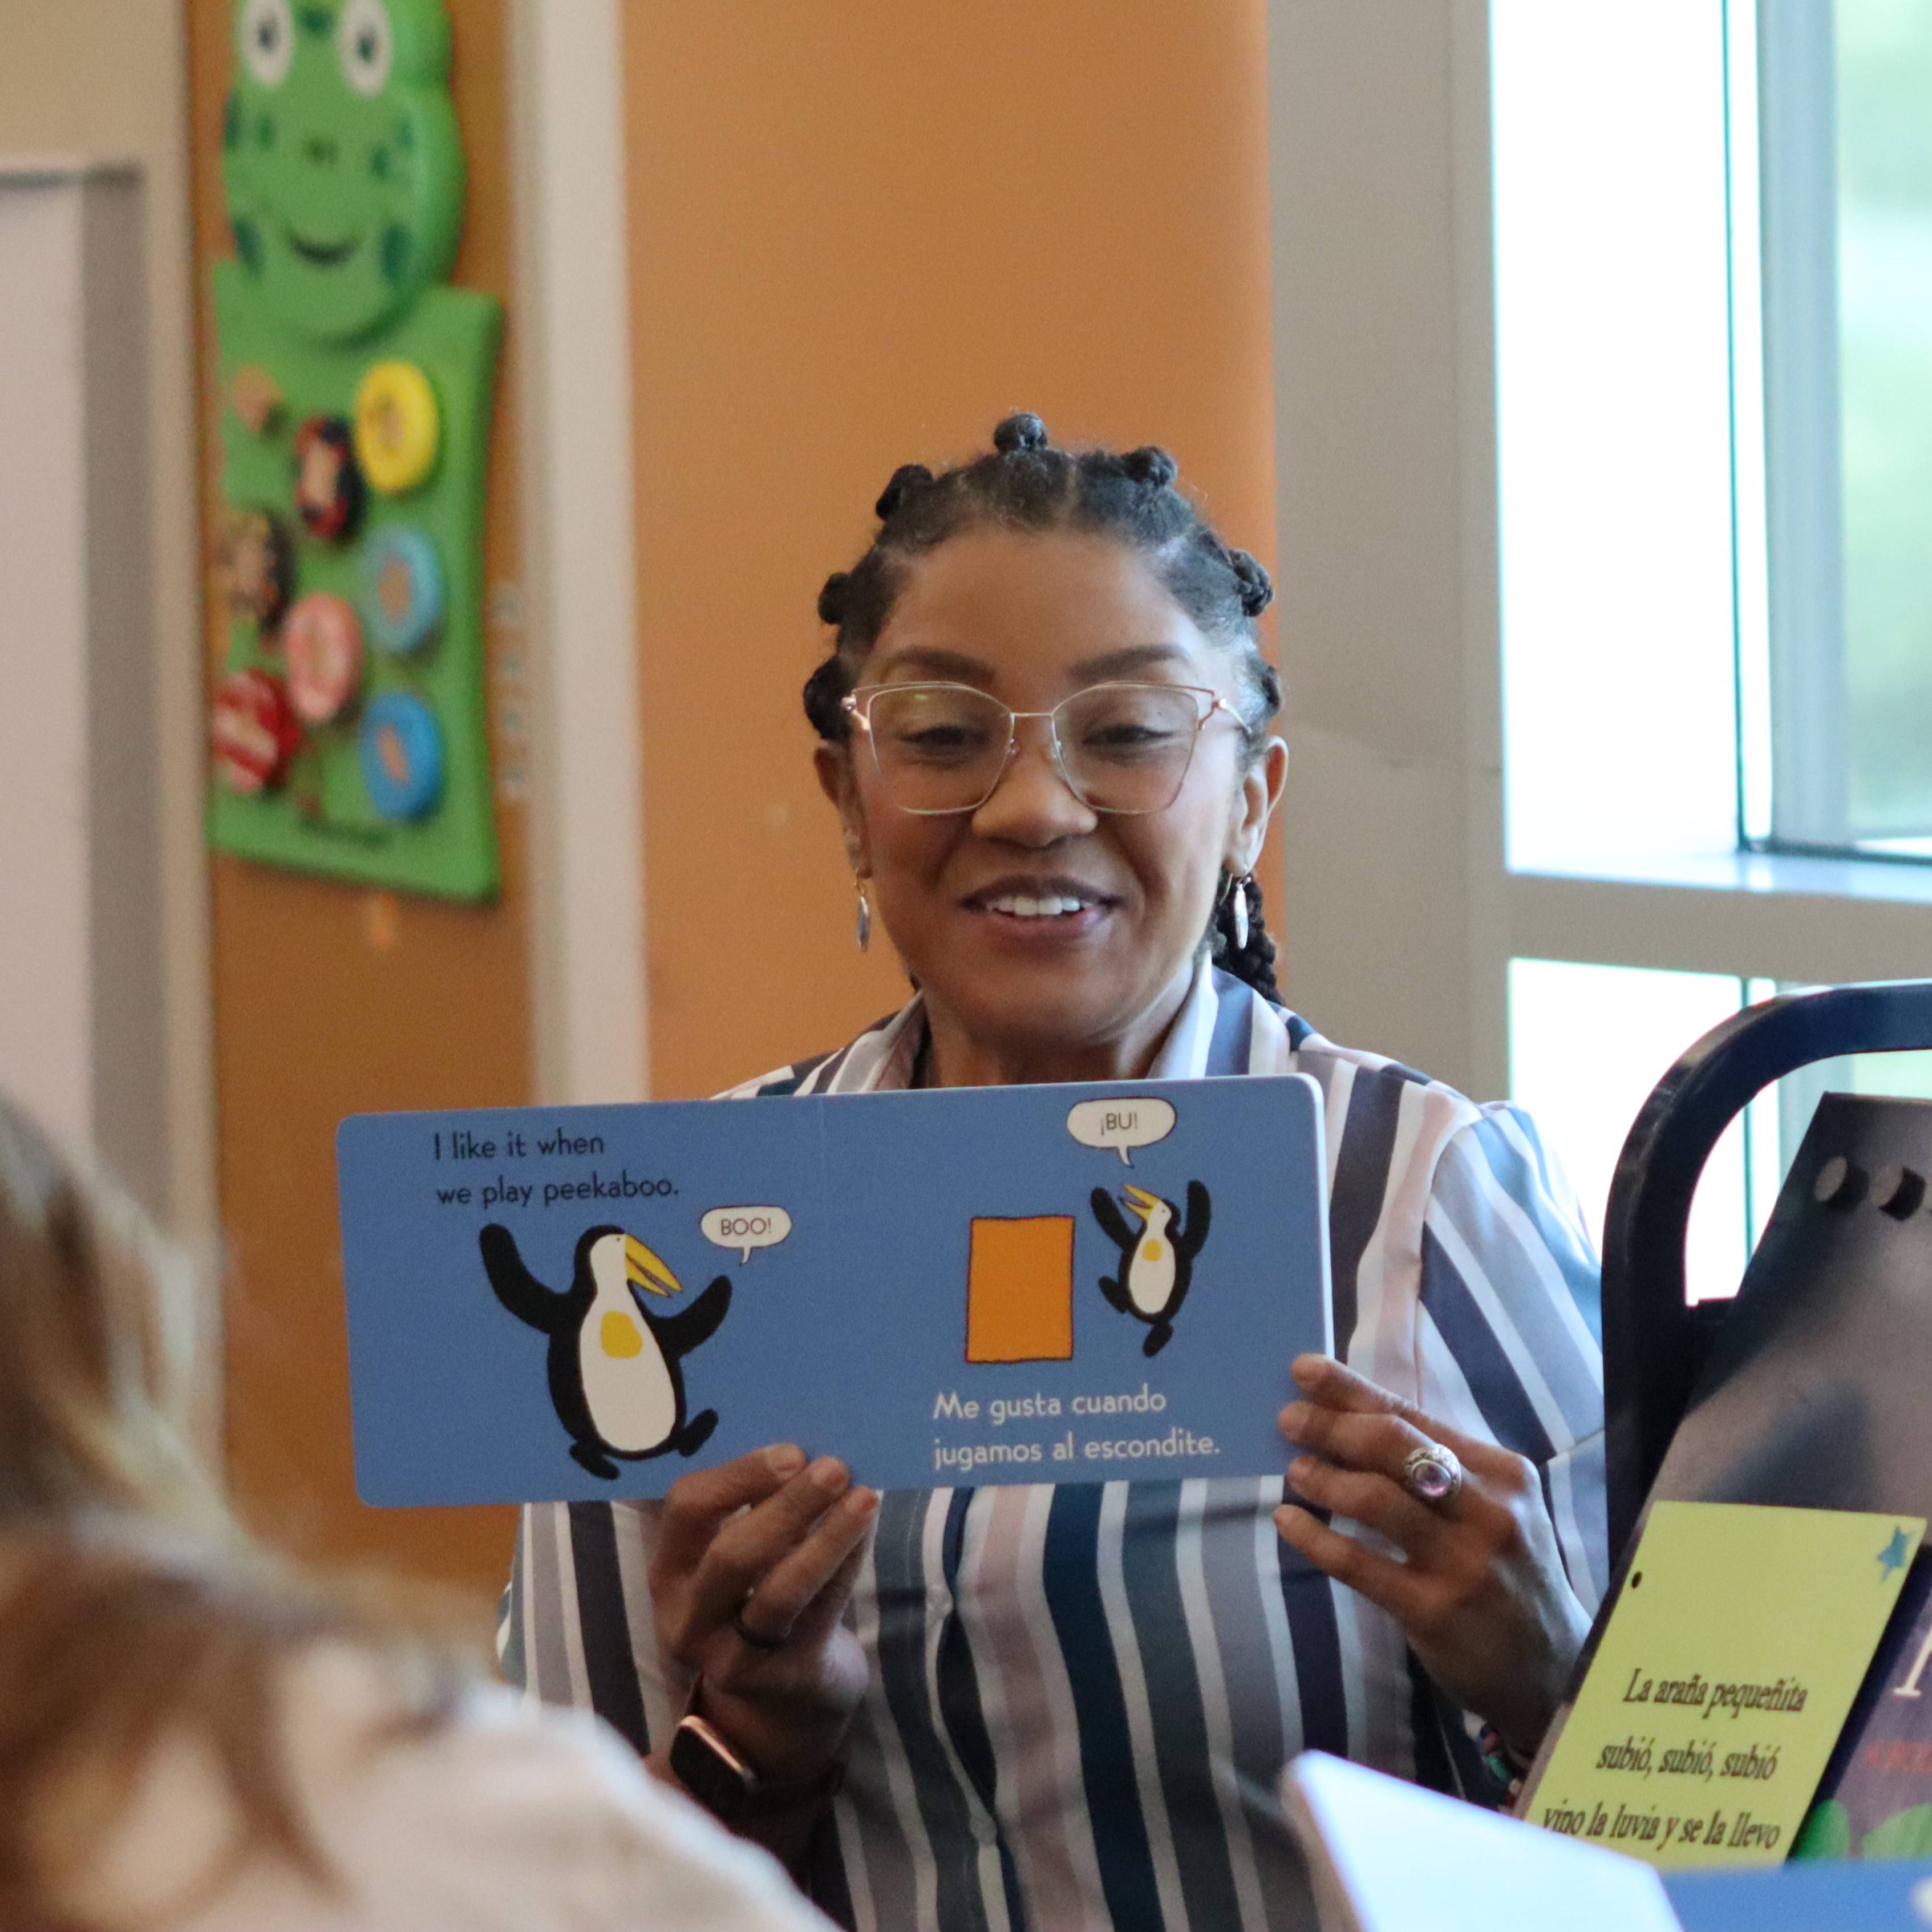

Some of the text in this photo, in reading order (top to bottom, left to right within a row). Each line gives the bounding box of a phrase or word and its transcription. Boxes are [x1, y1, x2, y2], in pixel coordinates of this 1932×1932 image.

[435, 1127, 604, 1160] I like it when
[437, 1170, 678, 1209] we play peekaboo.
[721, 1217, 771, 1236] BOO!
[933, 1382, 1167, 1425] Me gusta cuando
[933, 1427, 1220, 1471] jugamos al escondite.
[1623, 1668, 1652, 1702] La
[1654, 1674, 1708, 1705] araña
[1596, 1735, 1781, 1783] subió, subió, subió
[1543, 1799, 1781, 1851] vino la luvia y se la llevo
